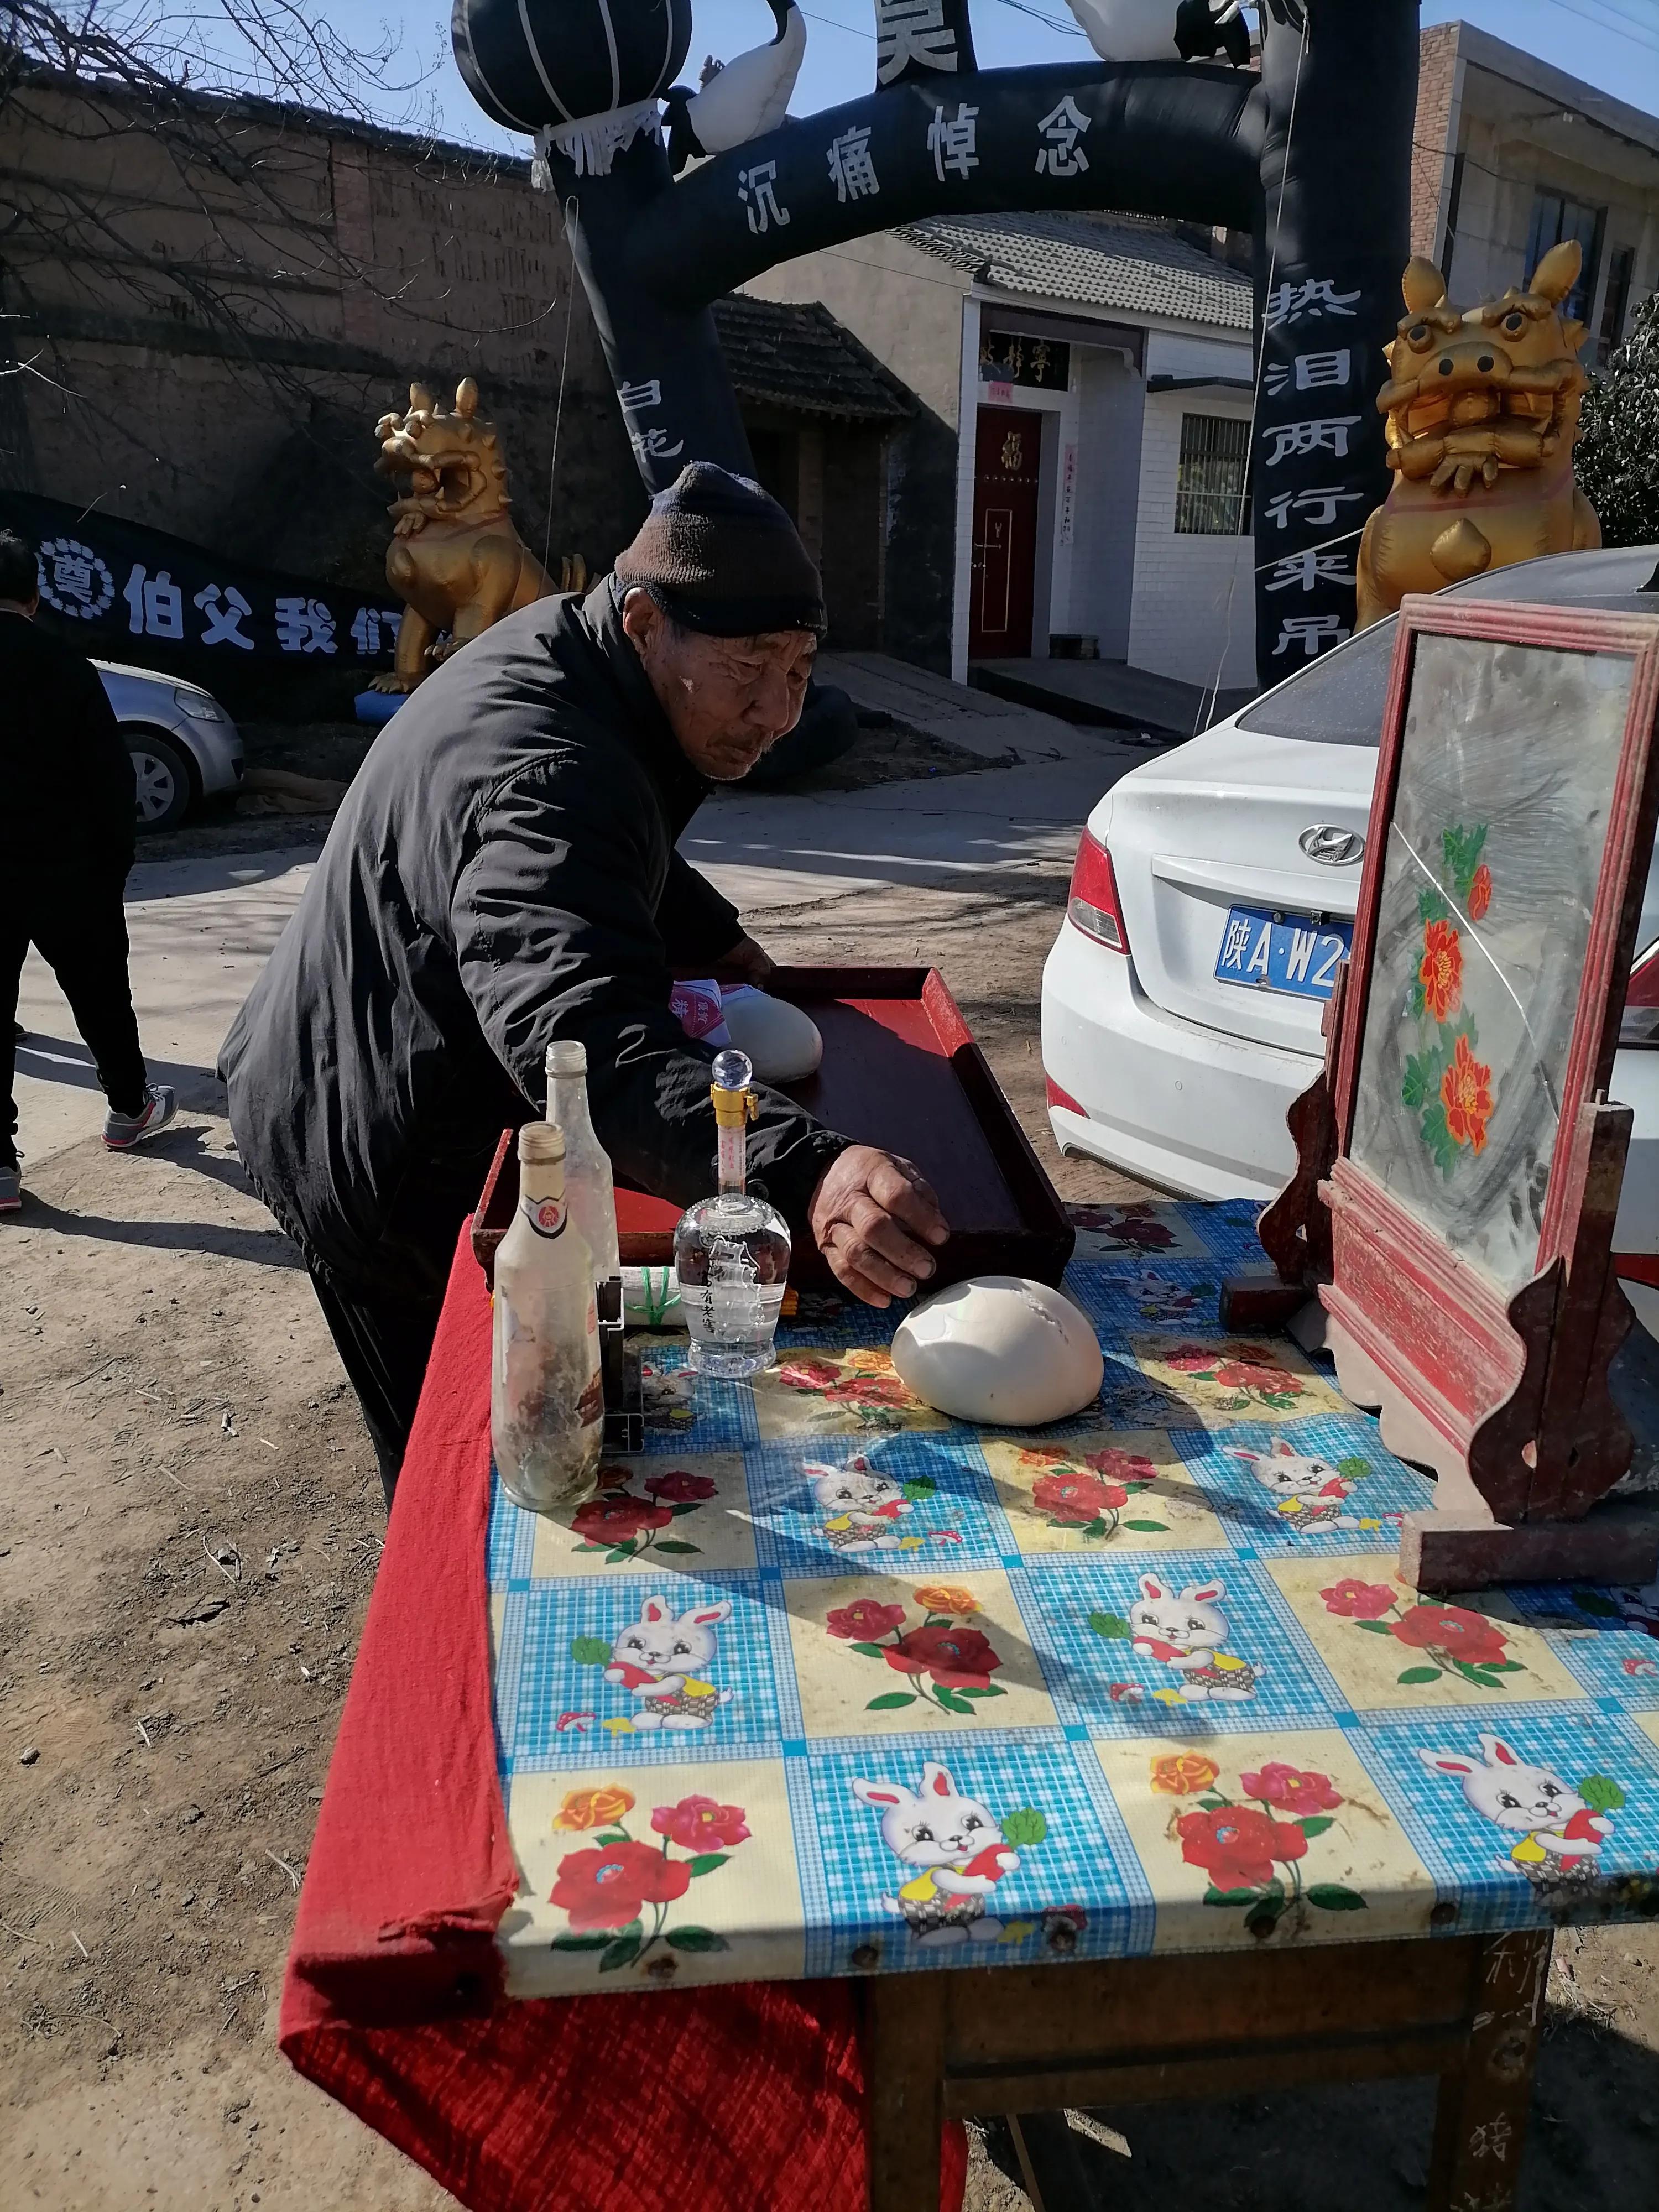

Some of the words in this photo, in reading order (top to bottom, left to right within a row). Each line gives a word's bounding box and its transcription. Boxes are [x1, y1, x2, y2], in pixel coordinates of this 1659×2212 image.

[738, 95, 1092, 234] 沉痛悼念
[617, 379, 684, 463] 白花
[1262, 278, 1364, 655] 热泪两行来吊
